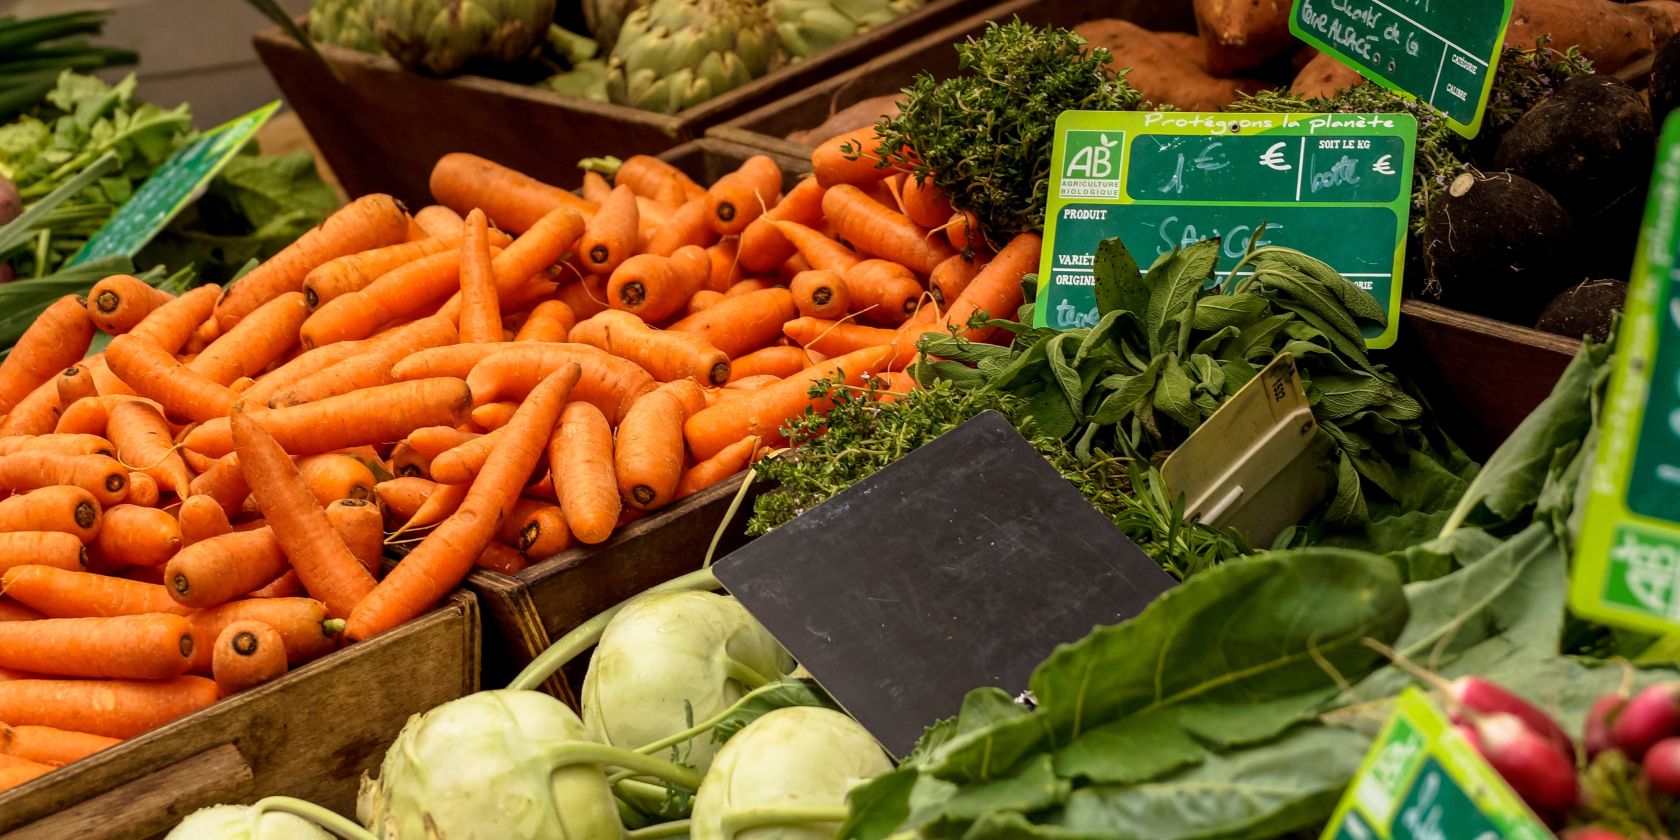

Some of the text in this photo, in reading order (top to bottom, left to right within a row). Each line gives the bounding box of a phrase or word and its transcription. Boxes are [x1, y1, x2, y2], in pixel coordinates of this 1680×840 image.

[1282, 113, 1300, 128] la
[1310, 113, 1395, 135] planète
[1318, 140, 1371, 149] SOIT LE KG
[1066, 145, 1113, 178] AB
[1259, 141, 1292, 171] €
[1372, 154, 1396, 175] €
[1060, 188, 1119, 196] BIOLOGIQUE
[1061, 180, 1119, 188] AGRICULTURE
[1063, 209, 1107, 220] PRODUIT
[1156, 216, 1284, 259] SAGE
[1058, 253, 1095, 266] VARIÉT
